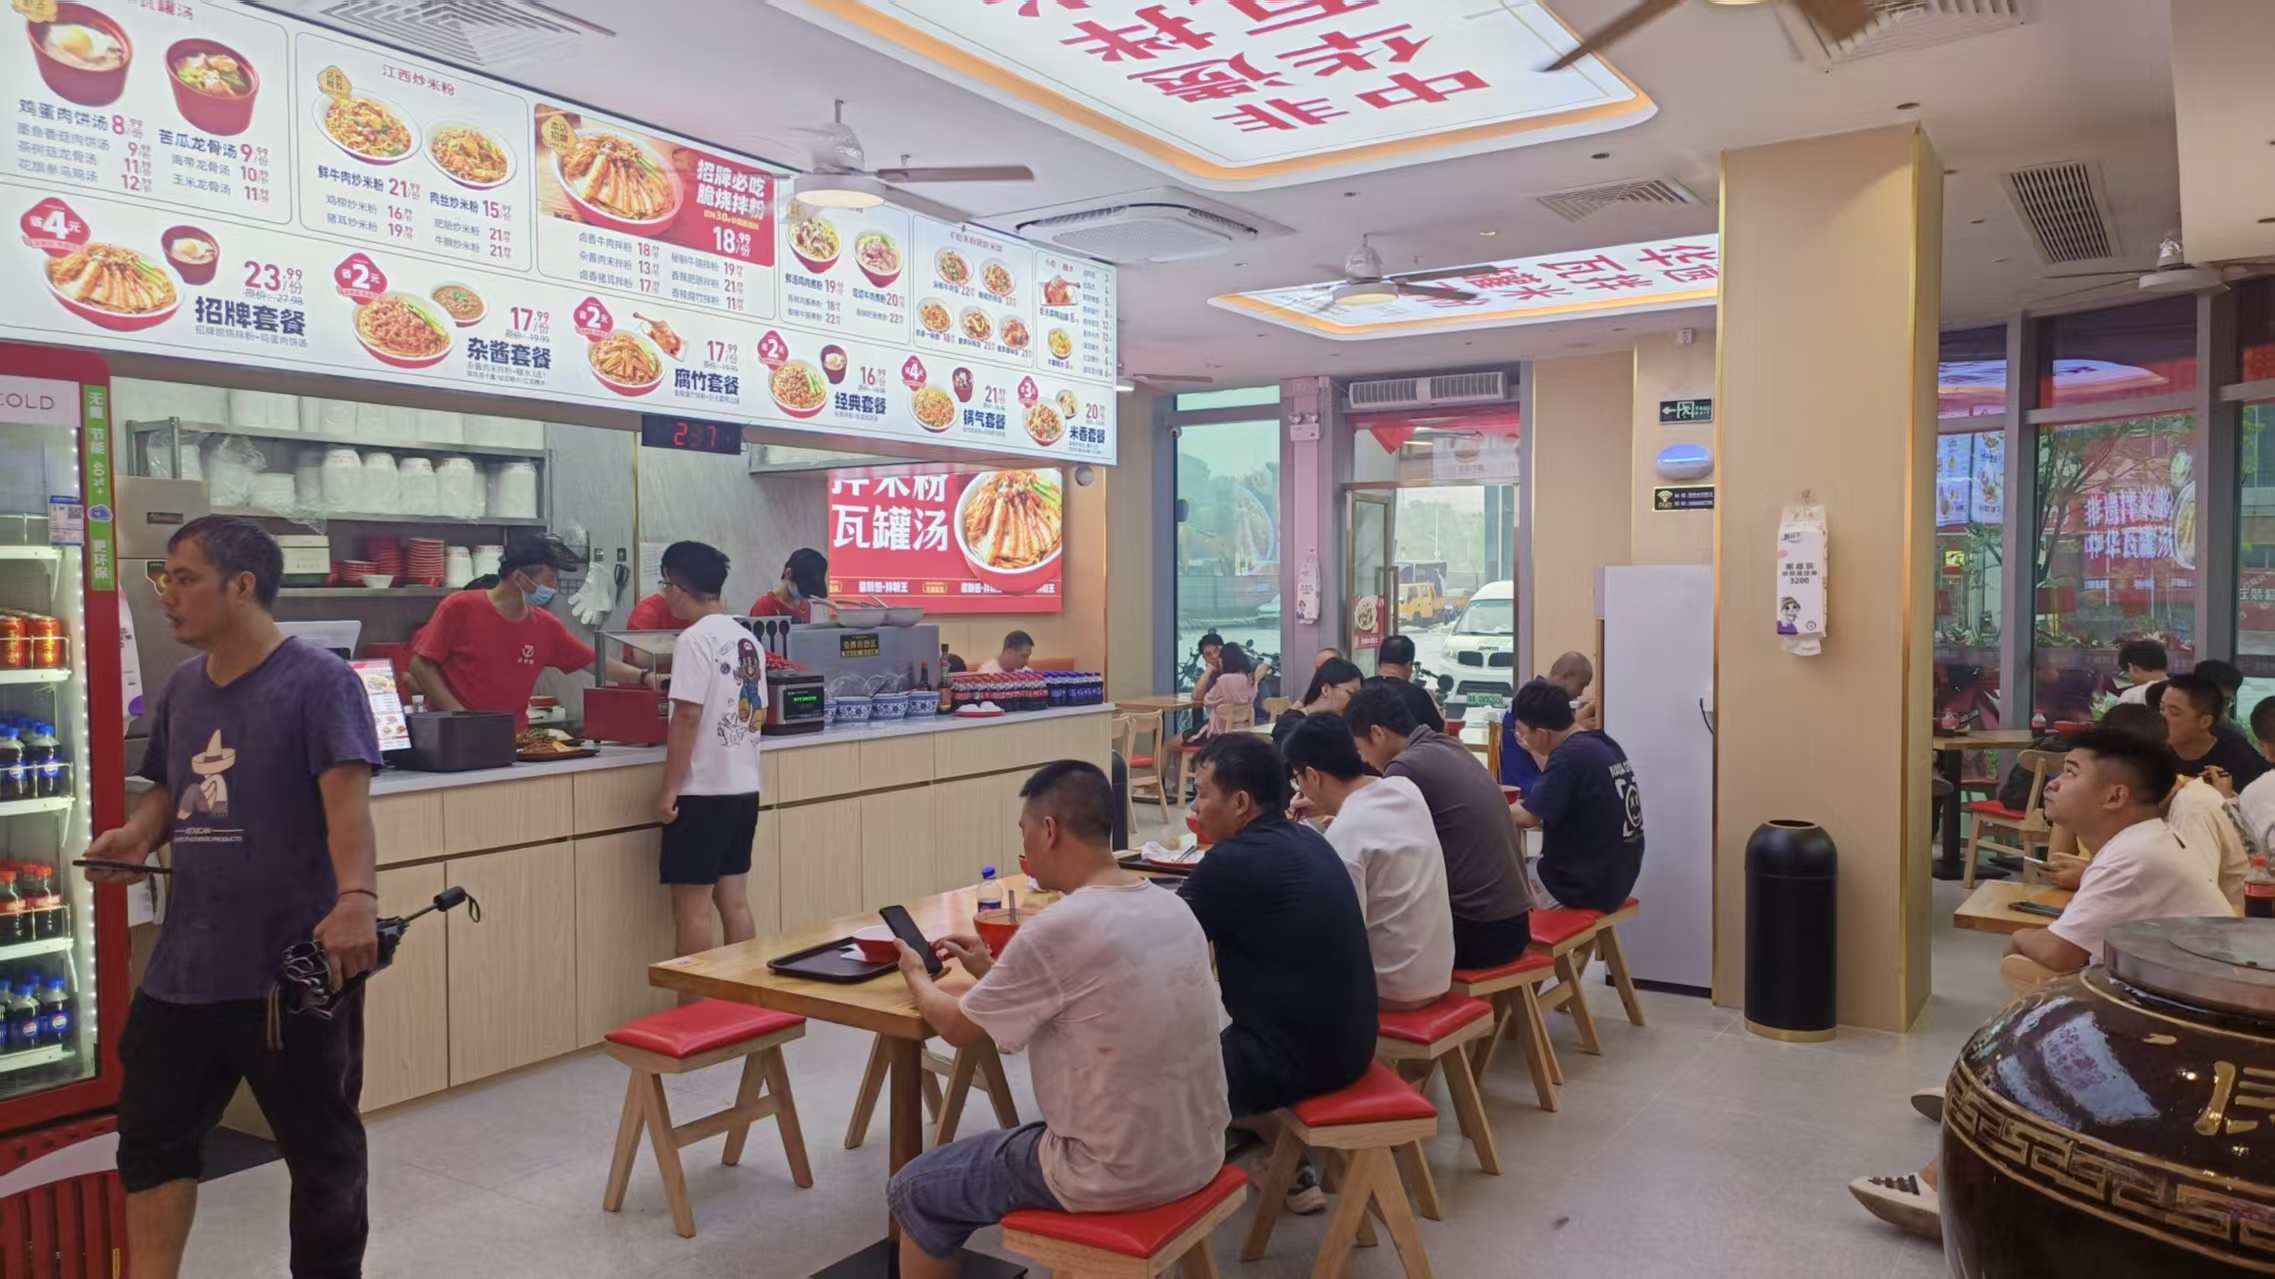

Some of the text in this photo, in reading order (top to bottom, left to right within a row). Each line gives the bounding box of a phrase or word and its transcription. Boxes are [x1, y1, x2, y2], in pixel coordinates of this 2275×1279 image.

[382, 64, 455, 95] 江西炒米粉
[18, 98, 109, 133] 鸡蛋肉饼汤
[159, 128, 238, 160] 苦瓜龙骨汤
[172, 173, 231, 195] 玉米龙骨汤
[317, 165, 385, 193] 鲜牛肉炒米粉
[697, 159, 766, 198] 招牌必吃
[429, 192, 479, 215] 肉丝炒米粉
[696, 184, 765, 221] 脆烧拌粉
[196, 296, 306, 337] 招牌套餐
[467, 337, 552, 370] 杂酱套餐
[675, 367, 740, 396] 腐竹套餐
[0, 392, 55, 411] OLD
[835, 392, 887, 415] 经典套餐
[963, 409, 1006, 430] 锅气套餐
[1069, 426, 1105, 444] 米香套餐
[832, 504, 948, 552] 瓦罐汤
